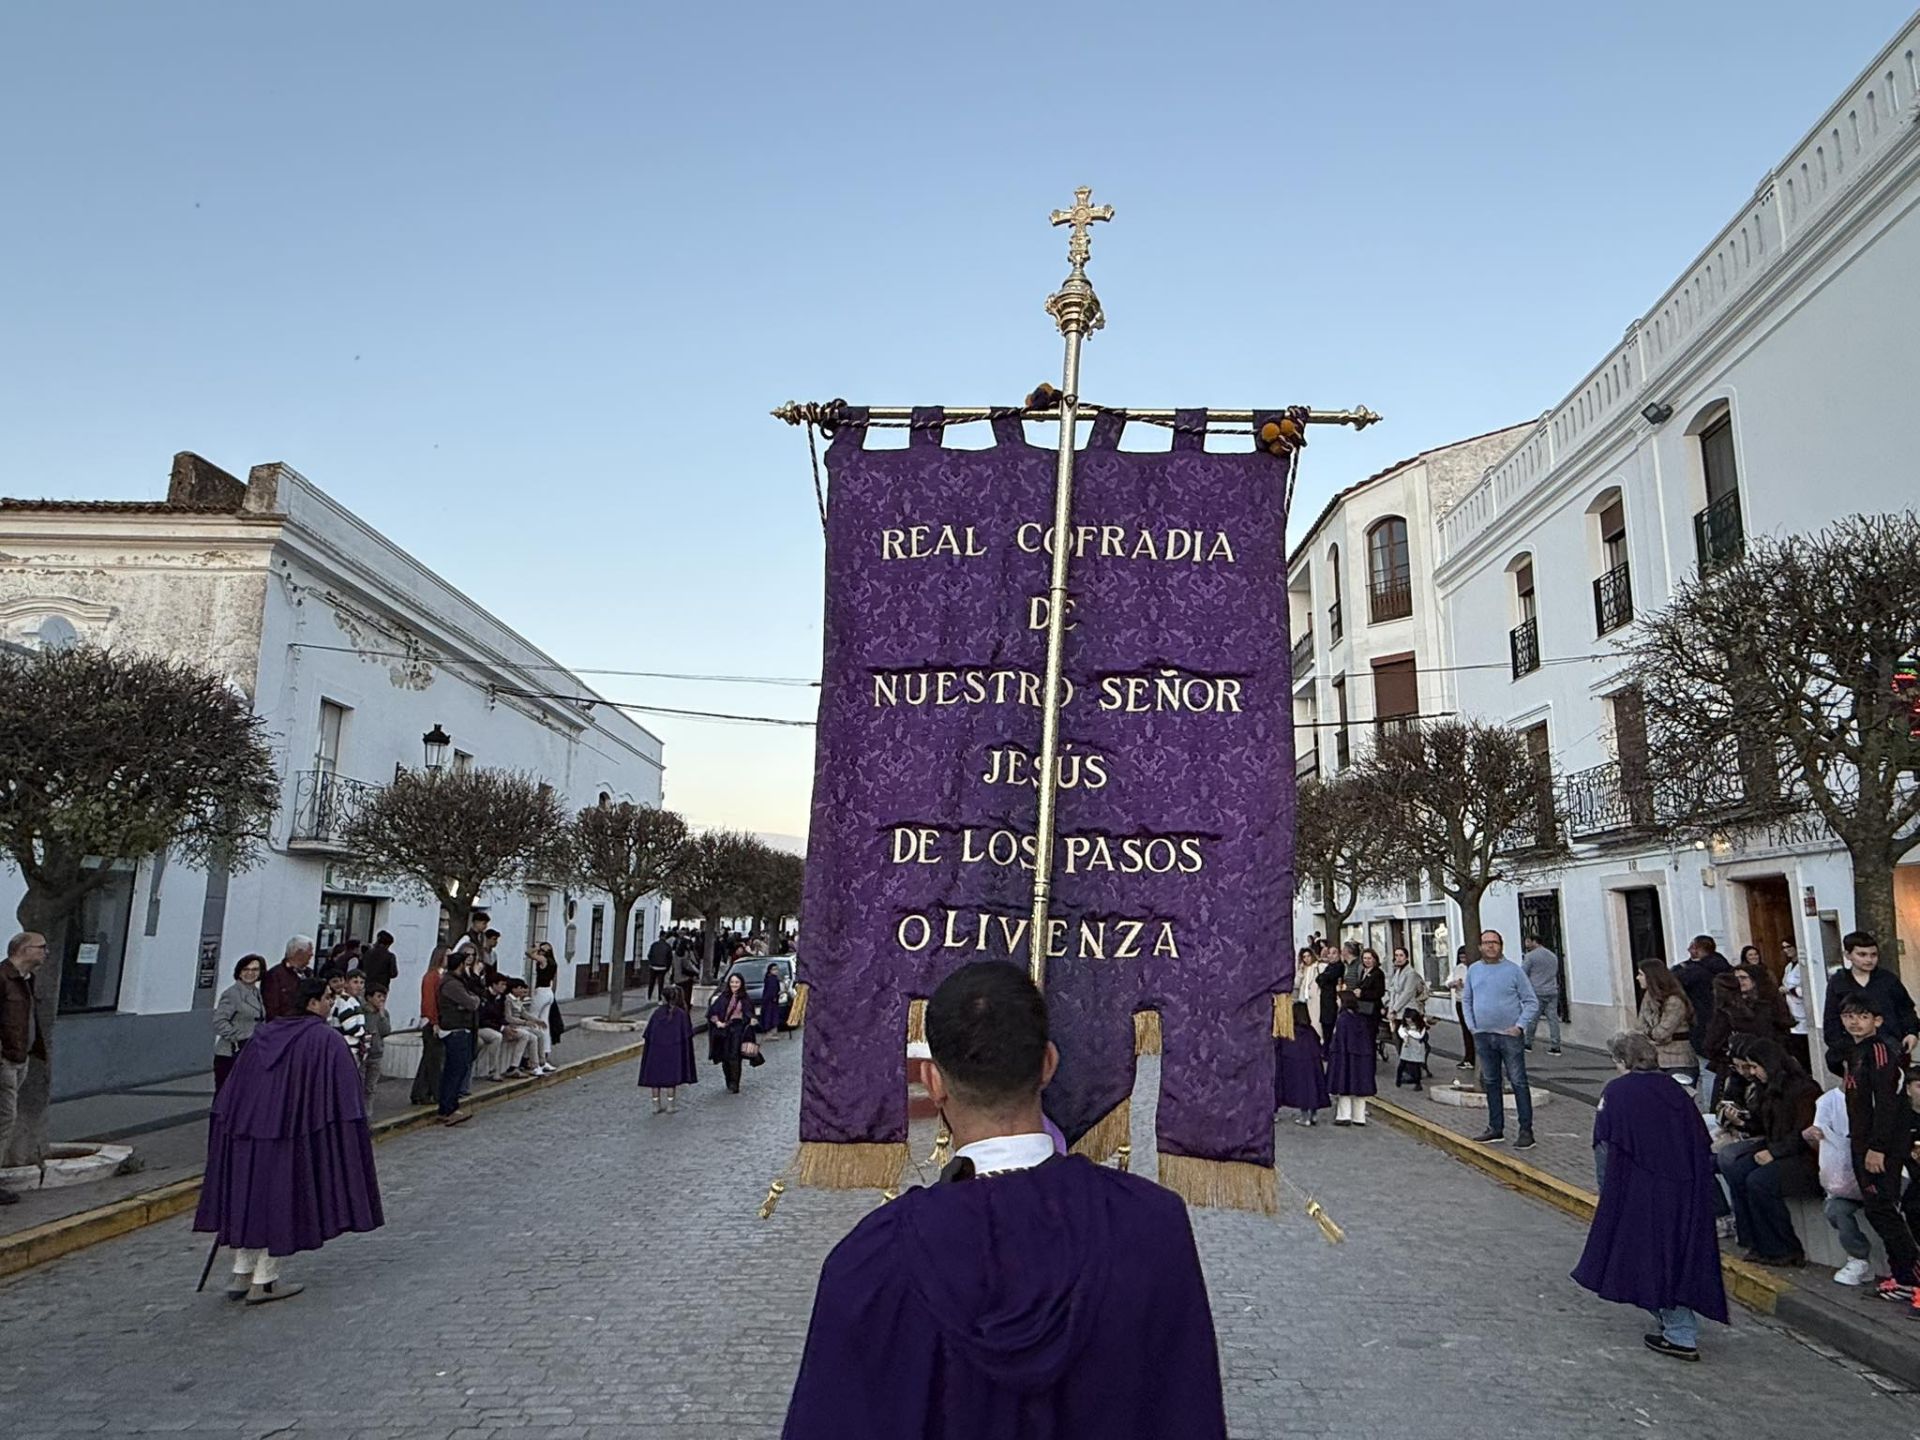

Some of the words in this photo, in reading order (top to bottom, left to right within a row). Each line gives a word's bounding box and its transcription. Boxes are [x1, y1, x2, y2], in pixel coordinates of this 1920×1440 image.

[881, 524, 988, 560] REAL
[1017, 522, 1236, 563] COFRADIA
[1098, 669, 1243, 713] SEÑOR
[892, 827, 942, 864] DE
[961, 829, 1038, 870] LOS
[1064, 836, 1203, 874] PASOS
[1767, 818, 1836, 847] FARMA
[898, 910, 1180, 960] OLIVENZA
